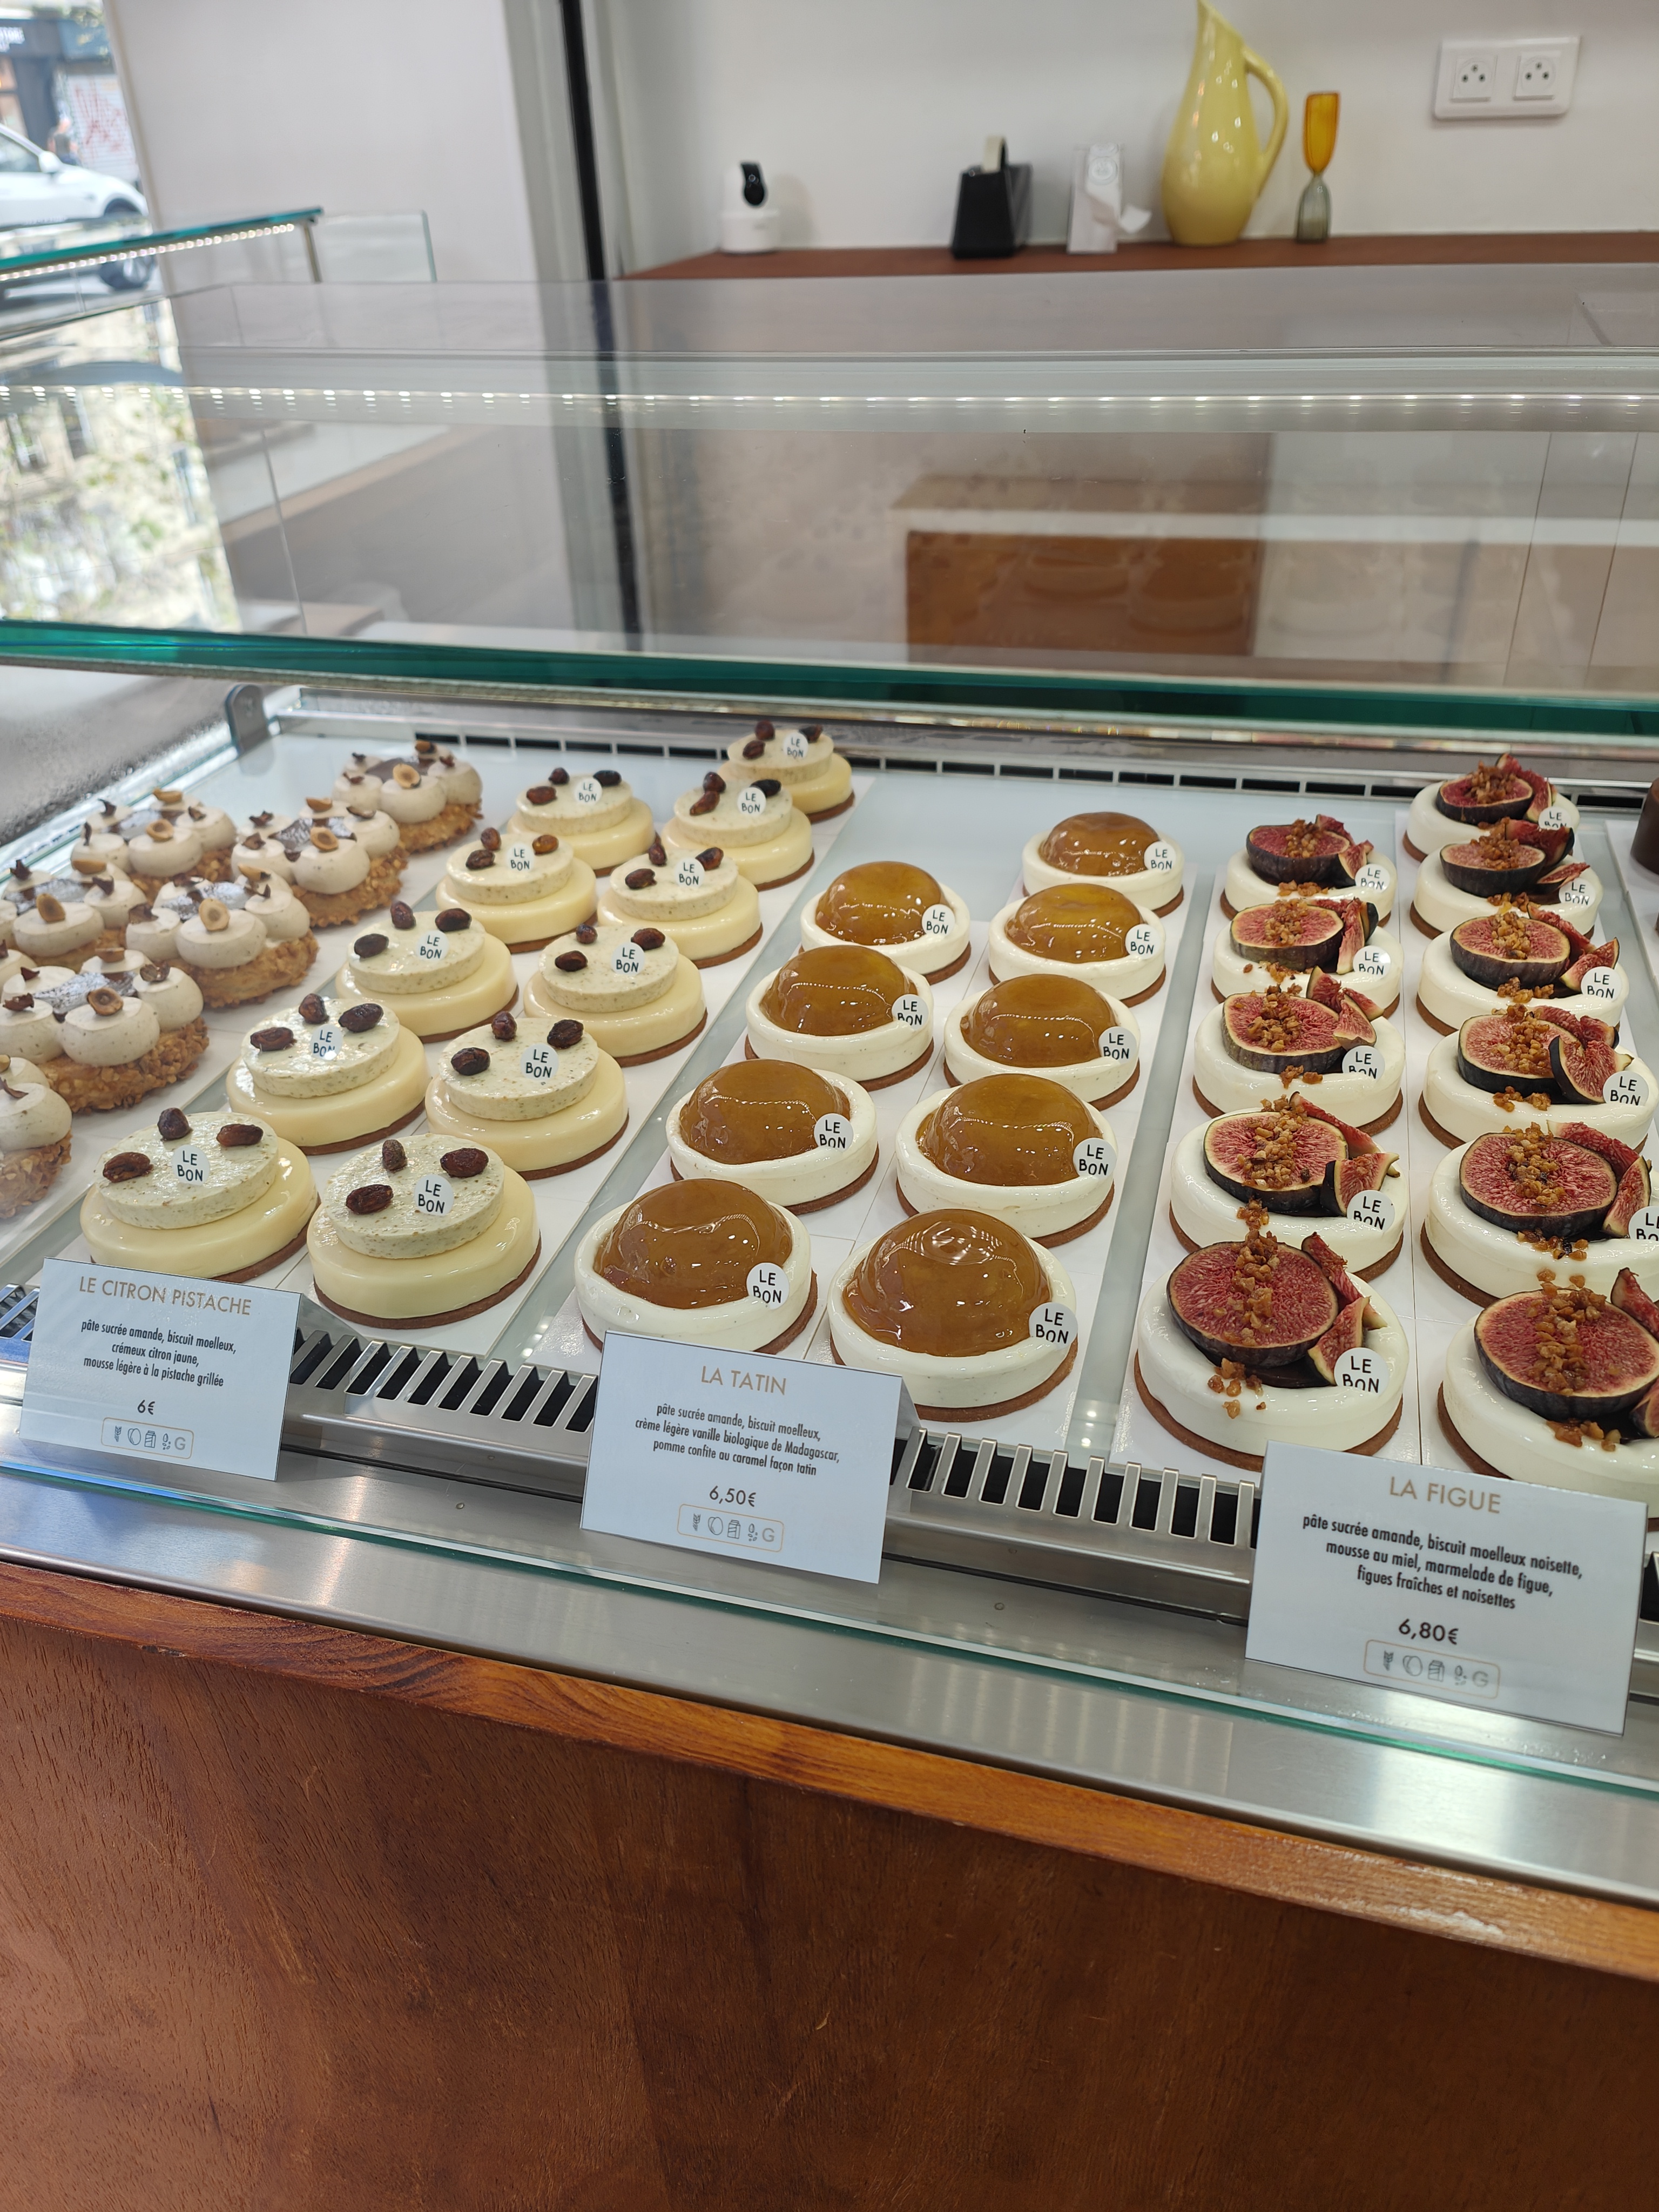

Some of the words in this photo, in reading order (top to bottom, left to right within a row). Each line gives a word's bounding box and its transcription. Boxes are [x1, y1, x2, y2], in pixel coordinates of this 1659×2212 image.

[791, 738, 800, 747] LE
[787, 746, 803, 759] BON
[583, 783, 592, 791] LE
[579, 793, 596, 802] BON
[746, 793, 756, 801] LE
[741, 803, 760, 813] BON
[1549, 812, 1561, 820] LE
[514, 849, 524, 858] LE
[1156, 849, 1167, 858] LE
[511, 860, 529, 871] BON
[684, 863, 694, 873] LE
[1151, 860, 1172, 870] BON
[679, 874, 699, 886] BON
[1368, 868, 1380, 878] LE
[1361, 878, 1384, 889] BON
[1572, 881, 1585, 893] LE
[1565, 892, 1589, 905] BON
[933, 910, 945, 921] LE
[926, 921, 948, 934] BON
[427, 935, 440, 946] LE
[1137, 930, 1150, 941] LE
[420, 946, 441, 959] BON
[623, 948, 635, 959] LE
[1131, 942, 1154, 954] BON
[1365, 952, 1379, 962] LE
[617, 960, 638, 973] BON
[1594, 973, 1609, 984] LE
[903, 1000, 917, 1011] LE
[320, 1030, 333, 1042] LE
[1109, 1033, 1124, 1045] LE
[534, 1049, 548, 1063] LE
[1103, 1047, 1129, 1060] BON
[1356, 1051, 1372, 1064] LE
[526, 1062, 552, 1077] BON
[1620, 1076, 1637, 1091] LE
[826, 1120, 840, 1134] LE
[820, 1133, 845, 1148] BON
[183, 1151, 197, 1165] LE
[1087, 1144, 1104, 1159] LE
[177, 1165, 203, 1181] BON
[1078, 1158, 1108, 1176] BON
[426, 1180, 441, 1197] LE
[419, 1193, 444, 1213] BON
[1363, 1196, 1381, 1213] LE
[760, 1270, 775, 1286] LE
[79, 1276, 97, 1293] LE
[102, 1280, 166, 1303] CITRON
[172, 1289, 252, 1315] PISTACHE
[753, 1285, 781, 1303] BON
[1045, 1309, 1063, 1326] LE
[81, 1319, 99, 1332] pâte
[102, 1324, 127, 1336] sucrée
[129, 1327, 164, 1344] amande,
[167, 1330, 193, 1345] biscuit
[196, 1336, 236, 1354] moelleux,
[1036, 1324, 1068, 1344] BON
[112, 1342, 146, 1357] crémeux
[149, 1347, 171, 1360] citron
[173, 1350, 199, 1367] jaune,
[1351, 1356, 1371, 1373] LE
[84, 1358, 113, 1370] mousse
[116, 1358, 141, 1375] légère
[143, 1363, 149, 1375] à
[151, 1363, 159, 1377] la
[161, 1367, 195, 1382] pistache
[197, 1372, 224, 1386] grillée
[702, 1366, 723, 1385] LA
[731, 1370, 786, 1395] TATIN
[1343, 1373, 1379, 1393] BON
[137, 1400, 155, 1415] 6€
[657, 1403, 675, 1416] pâte
[678, 1408, 705, 1421] sucrée
[707, 1413, 745, 1429] amande,
[748, 1415, 775, 1432] biscuit
[778, 1424, 820, 1441] moelleux,
[174, 1437, 186, 1451] G
[635, 1418, 660, 1431] crème
[663, 1420, 689, 1437] légère
[692, 1427, 720, 1441] vanille
[724, 1429, 768, 1451] biologique
[771, 1438, 782, 1451] de
[785, 1441, 839, 1464] Madagascar,
[653, 1440, 685, 1452] pomme
[688, 1445, 716, 1458] confite
[719, 1451, 730, 1461] au
[733, 1455, 767, 1467] caramel
[770, 1456, 793, 1473] façon
[797, 1462, 817, 1476] tatin
[710, 1486, 756, 1507] 6,50€
[1390, 1476, 1417, 1500] LA
[1427, 1483, 1501, 1514] FIGUE
[762, 1528, 774, 1542] G
[1303, 1514, 1328, 1529] pâte
[1331, 1522, 1368, 1537] sucrée
[1372, 1530, 1423, 1550] amande,
[1427, 1533, 1466, 1555] biscuit
[1469, 1546, 1526, 1566] moelleux
[1530, 1556, 1582, 1580] noisette,
[1326, 1542, 1370, 1560] mousse
[1373, 1551, 1388, 1563] au
[1392, 1553, 1421, 1573] miel,
[1425, 1560, 1495, 1583] marmelade
[1499, 1569, 1514, 1587] de
[1517, 1572, 1553, 1597] figue,
[1357, 1564, 1393, 1586] figues
[1397, 1572, 1443, 1595] fraîches
[1446, 1586, 1458, 1599] et
[1462, 1588, 1515, 1609] noisettes
[1398, 1618, 1459, 1645] 6,80€
[1472, 1670, 1489, 1688] G
